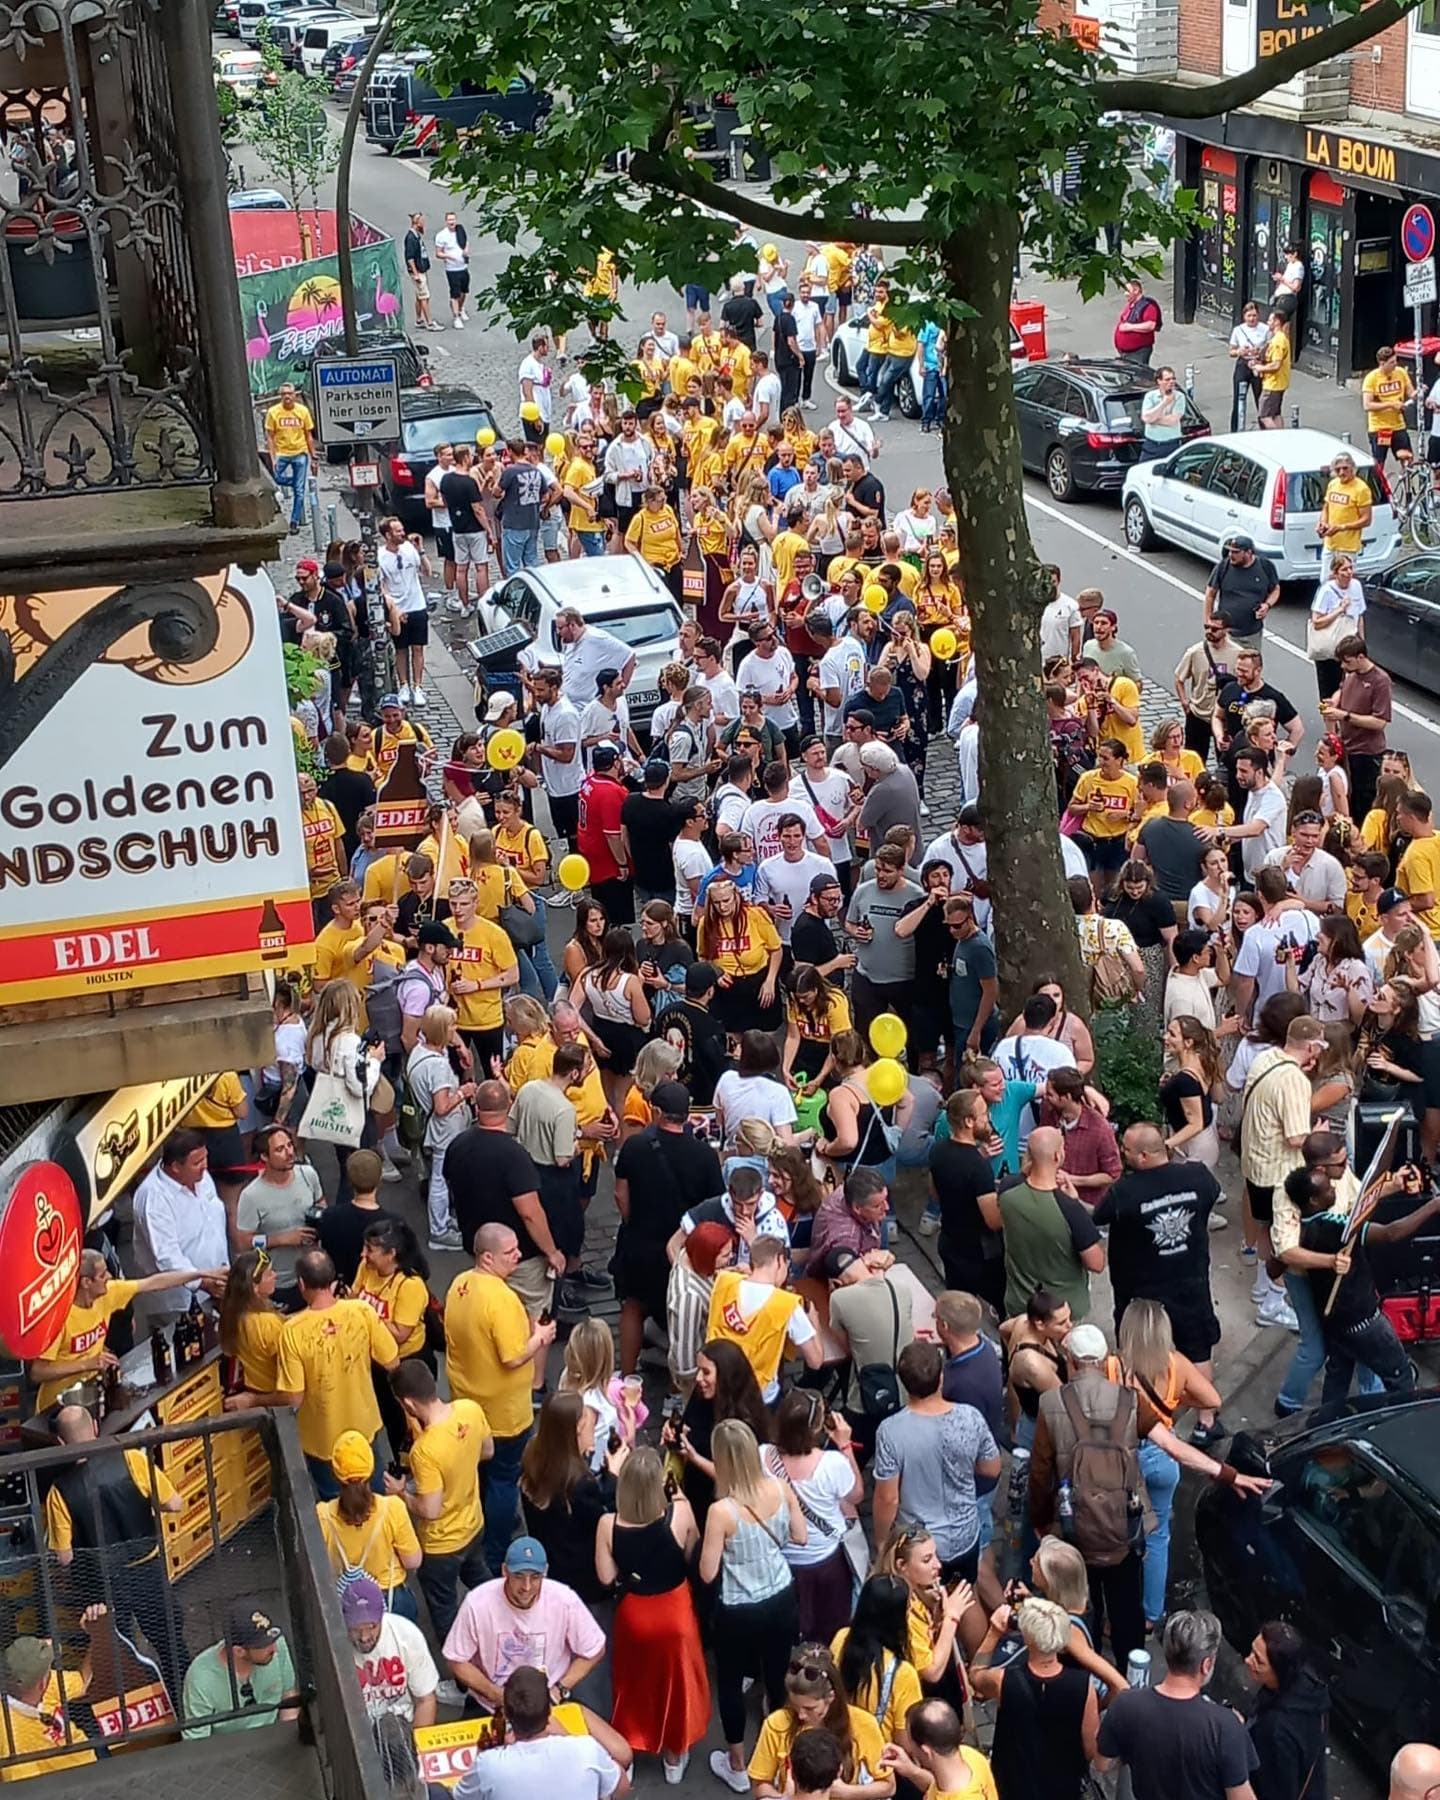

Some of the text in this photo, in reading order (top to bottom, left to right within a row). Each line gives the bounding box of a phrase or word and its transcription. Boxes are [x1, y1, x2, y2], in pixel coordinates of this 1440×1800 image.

[1306, 130, 1395, 181] LA BOUM
[326, 367, 389, 383] AUTOMAT
[326, 388, 393, 402] Parkschein
[329, 406, 353, 417] hier
[141, 713, 268, 758] Zum
[1, 769, 274, 829] Goldenen
[376, 808, 427, 828] EDEL
[53, 927, 286, 971] EDEL EDEL
[86, 970, 135, 985] HOLSTEN
[310, 1116, 353, 1135] HOLSTEN
[28, 1246, 77, 1318] ASTRA
[99, 1696, 169, 1738] EDEL
